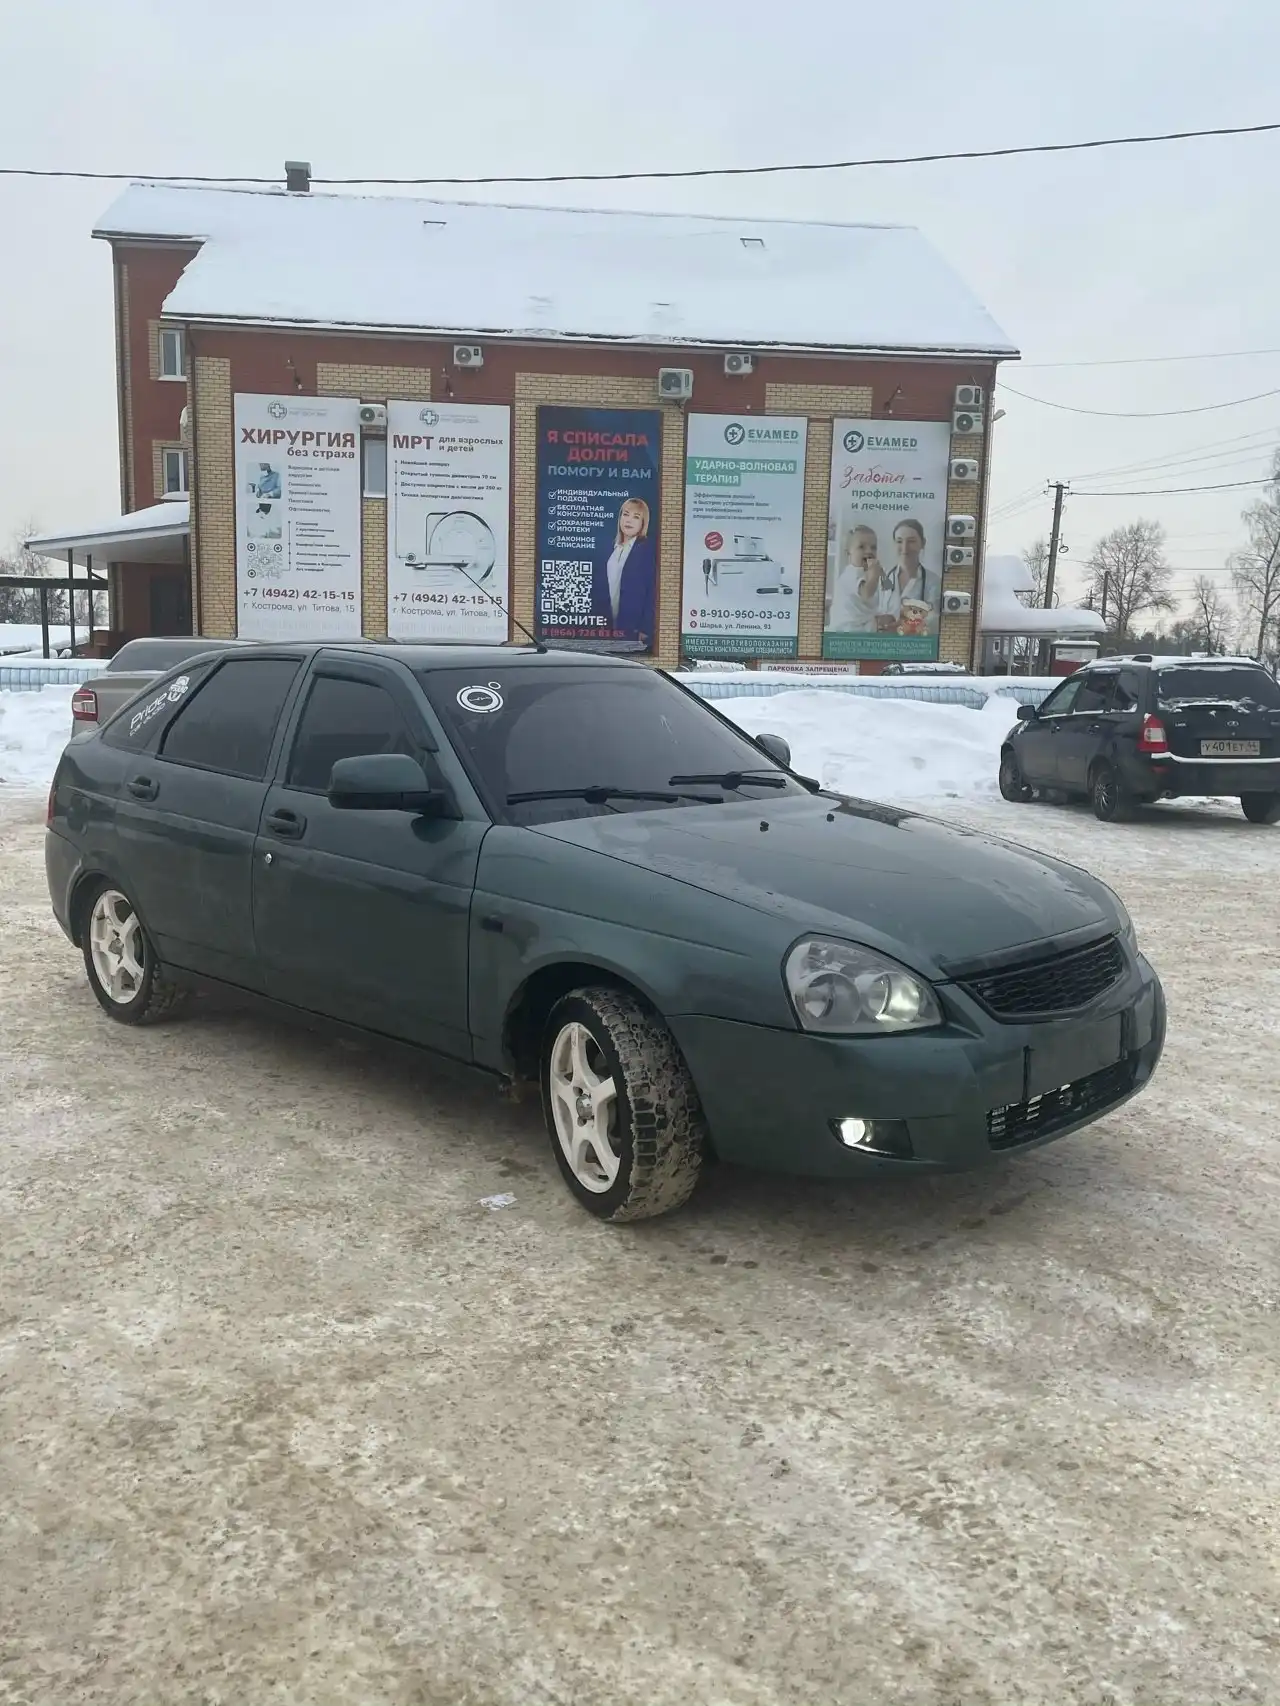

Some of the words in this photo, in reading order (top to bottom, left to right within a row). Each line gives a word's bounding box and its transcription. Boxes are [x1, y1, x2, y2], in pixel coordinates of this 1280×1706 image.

[241, 428, 355, 448] ХИРУРГИЯ
[547, 430, 558, 443] Я
[563, 431, 649, 446] СПИСАЛА
[748, 429, 799, 440] EVAMED
[393, 434, 435, 450] МРТ
[438, 436, 456, 444] для
[458, 437, 504, 445] взрослых
[867, 436, 918, 448] EVAMED
[287, 447, 308, 457] без
[312, 450, 355, 459] страха
[567, 447, 629, 462] ДОЛГИ
[695, 460, 794, 471] УДАРНО-ВОЛНОВАЯ
[548, 465, 604, 477] ПОМОГУ
[608, 468, 617, 477] И
[622, 468, 652, 479] ВАМ
[839, 463, 905, 489] Забота
[695, 474, 739, 484] ТЕРАПИЯ
[557, 489, 629, 498] ИНДИВИДУАЛЬНЫЙ
[851, 489, 935, 501] профилактика
[861, 503, 910, 511] лечение
[557, 511, 614, 519] КОНСУЛЬТАЦИЯ
[243, 588, 257, 597] +7
[262, 588, 299, 599] (4942)
[302, 589, 355, 600] 42-15-15
[393, 593, 407, 601] +7
[411, 593, 448, 604] (4942)
[452, 595, 503, 605] 42-15-15
[252, 601, 295, 612] Кострома,
[312, 603, 342, 613] Титова,
[345, 605, 355, 613] 15
[401, 606, 444, 616] Кострома,
[460, 609, 490, 618] Титова,
[493, 610, 503, 618] 15
[541, 614, 607, 626] ЗВОНИТЕ:
[700, 609, 791, 619] 8-910-950-03-03
[767, 665, 803, 673] ПАРКОВКА
[130, 693, 167, 729] Pride
